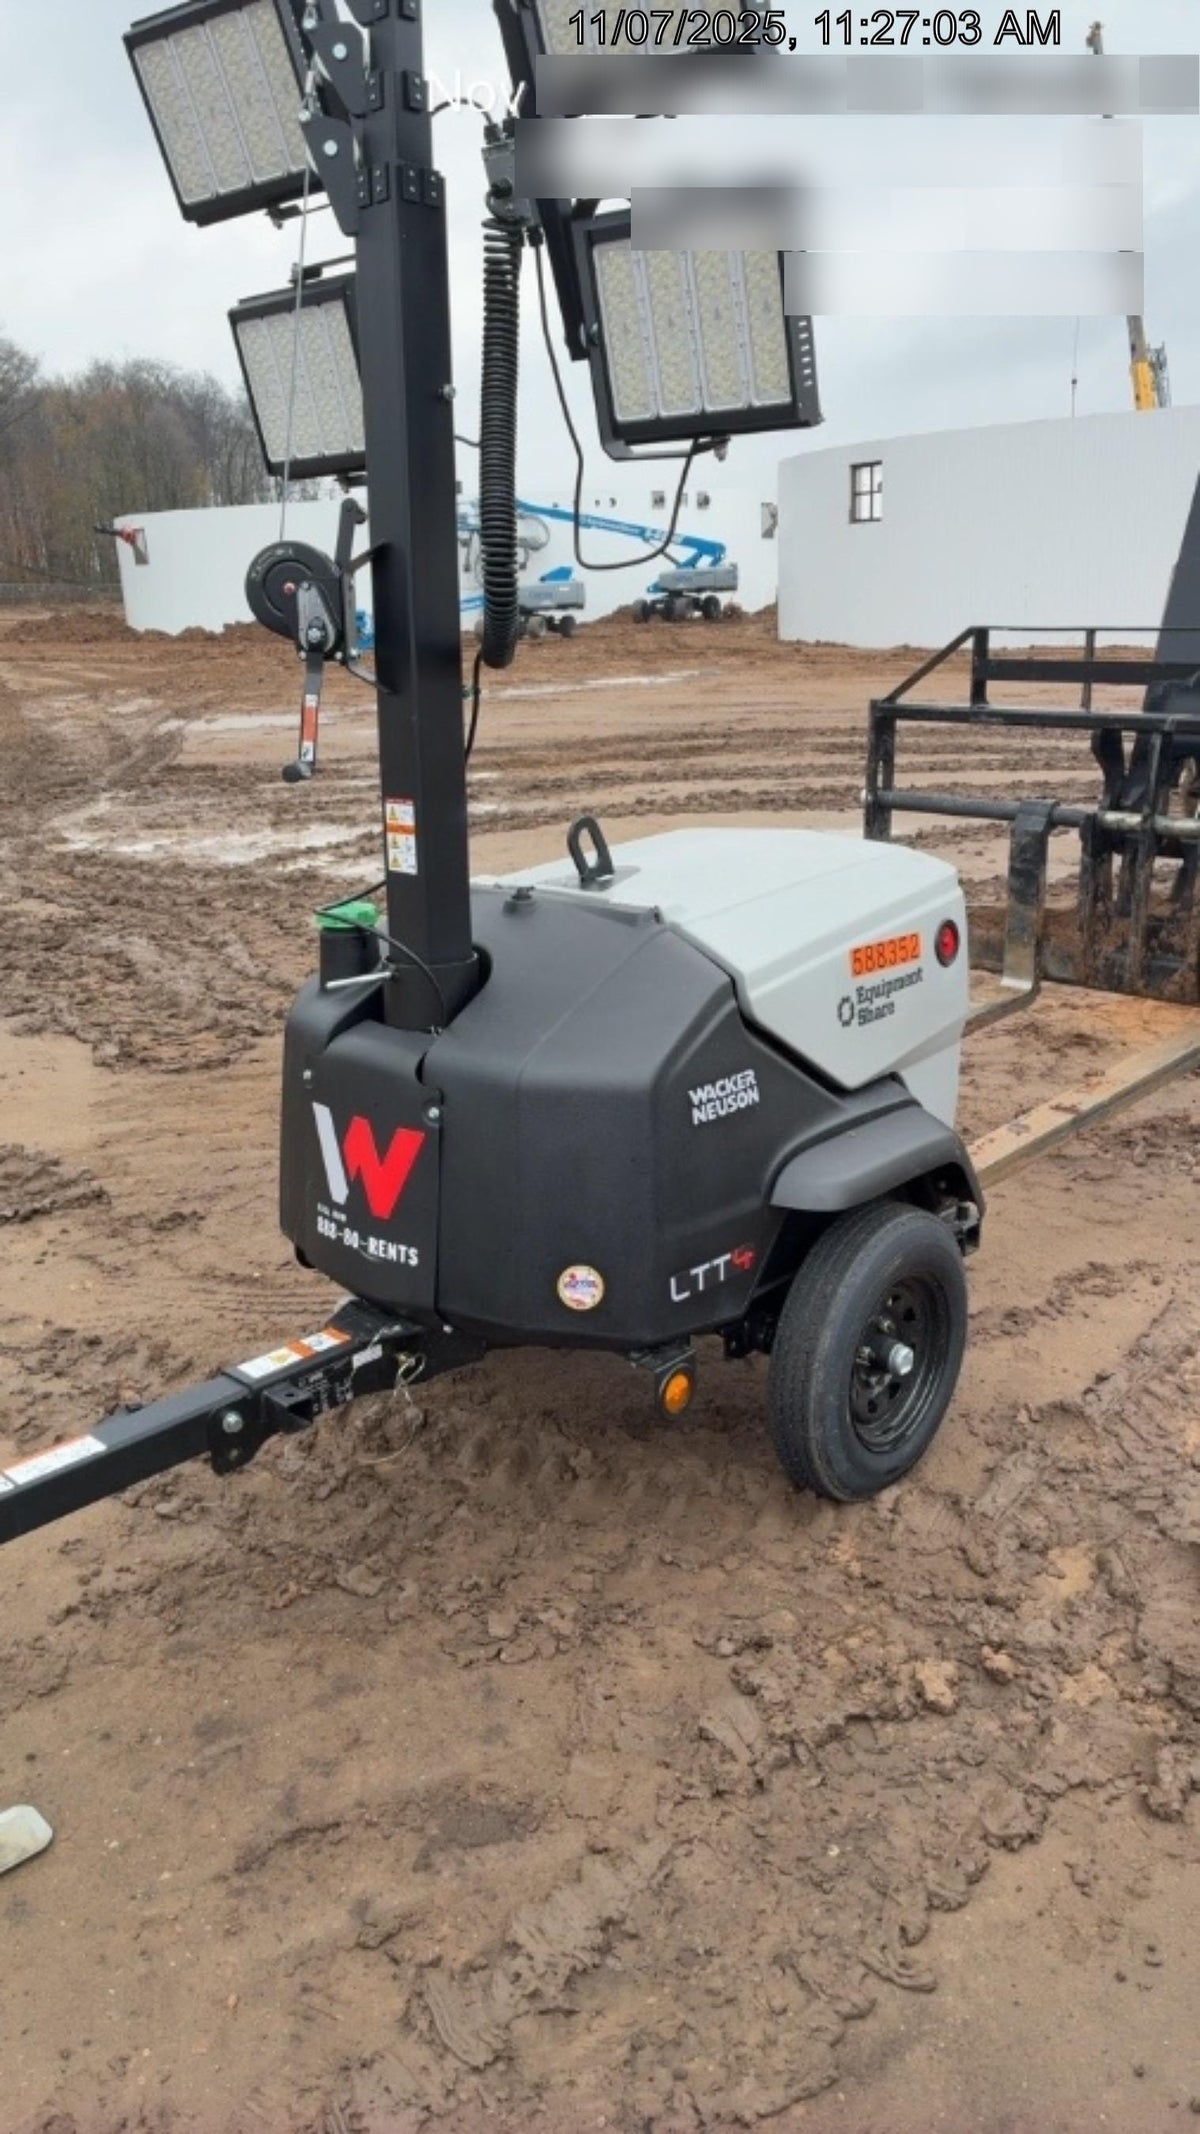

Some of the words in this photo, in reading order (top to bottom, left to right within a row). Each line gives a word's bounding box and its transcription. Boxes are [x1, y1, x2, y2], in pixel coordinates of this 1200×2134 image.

[852, 932, 920, 976] 588352
[856, 967, 923, 1005] Equipment
[858, 1001, 895, 1027] Share
[687, 1069, 757, 1106] WACKER
[692, 1085, 759, 1126] NEUSON
